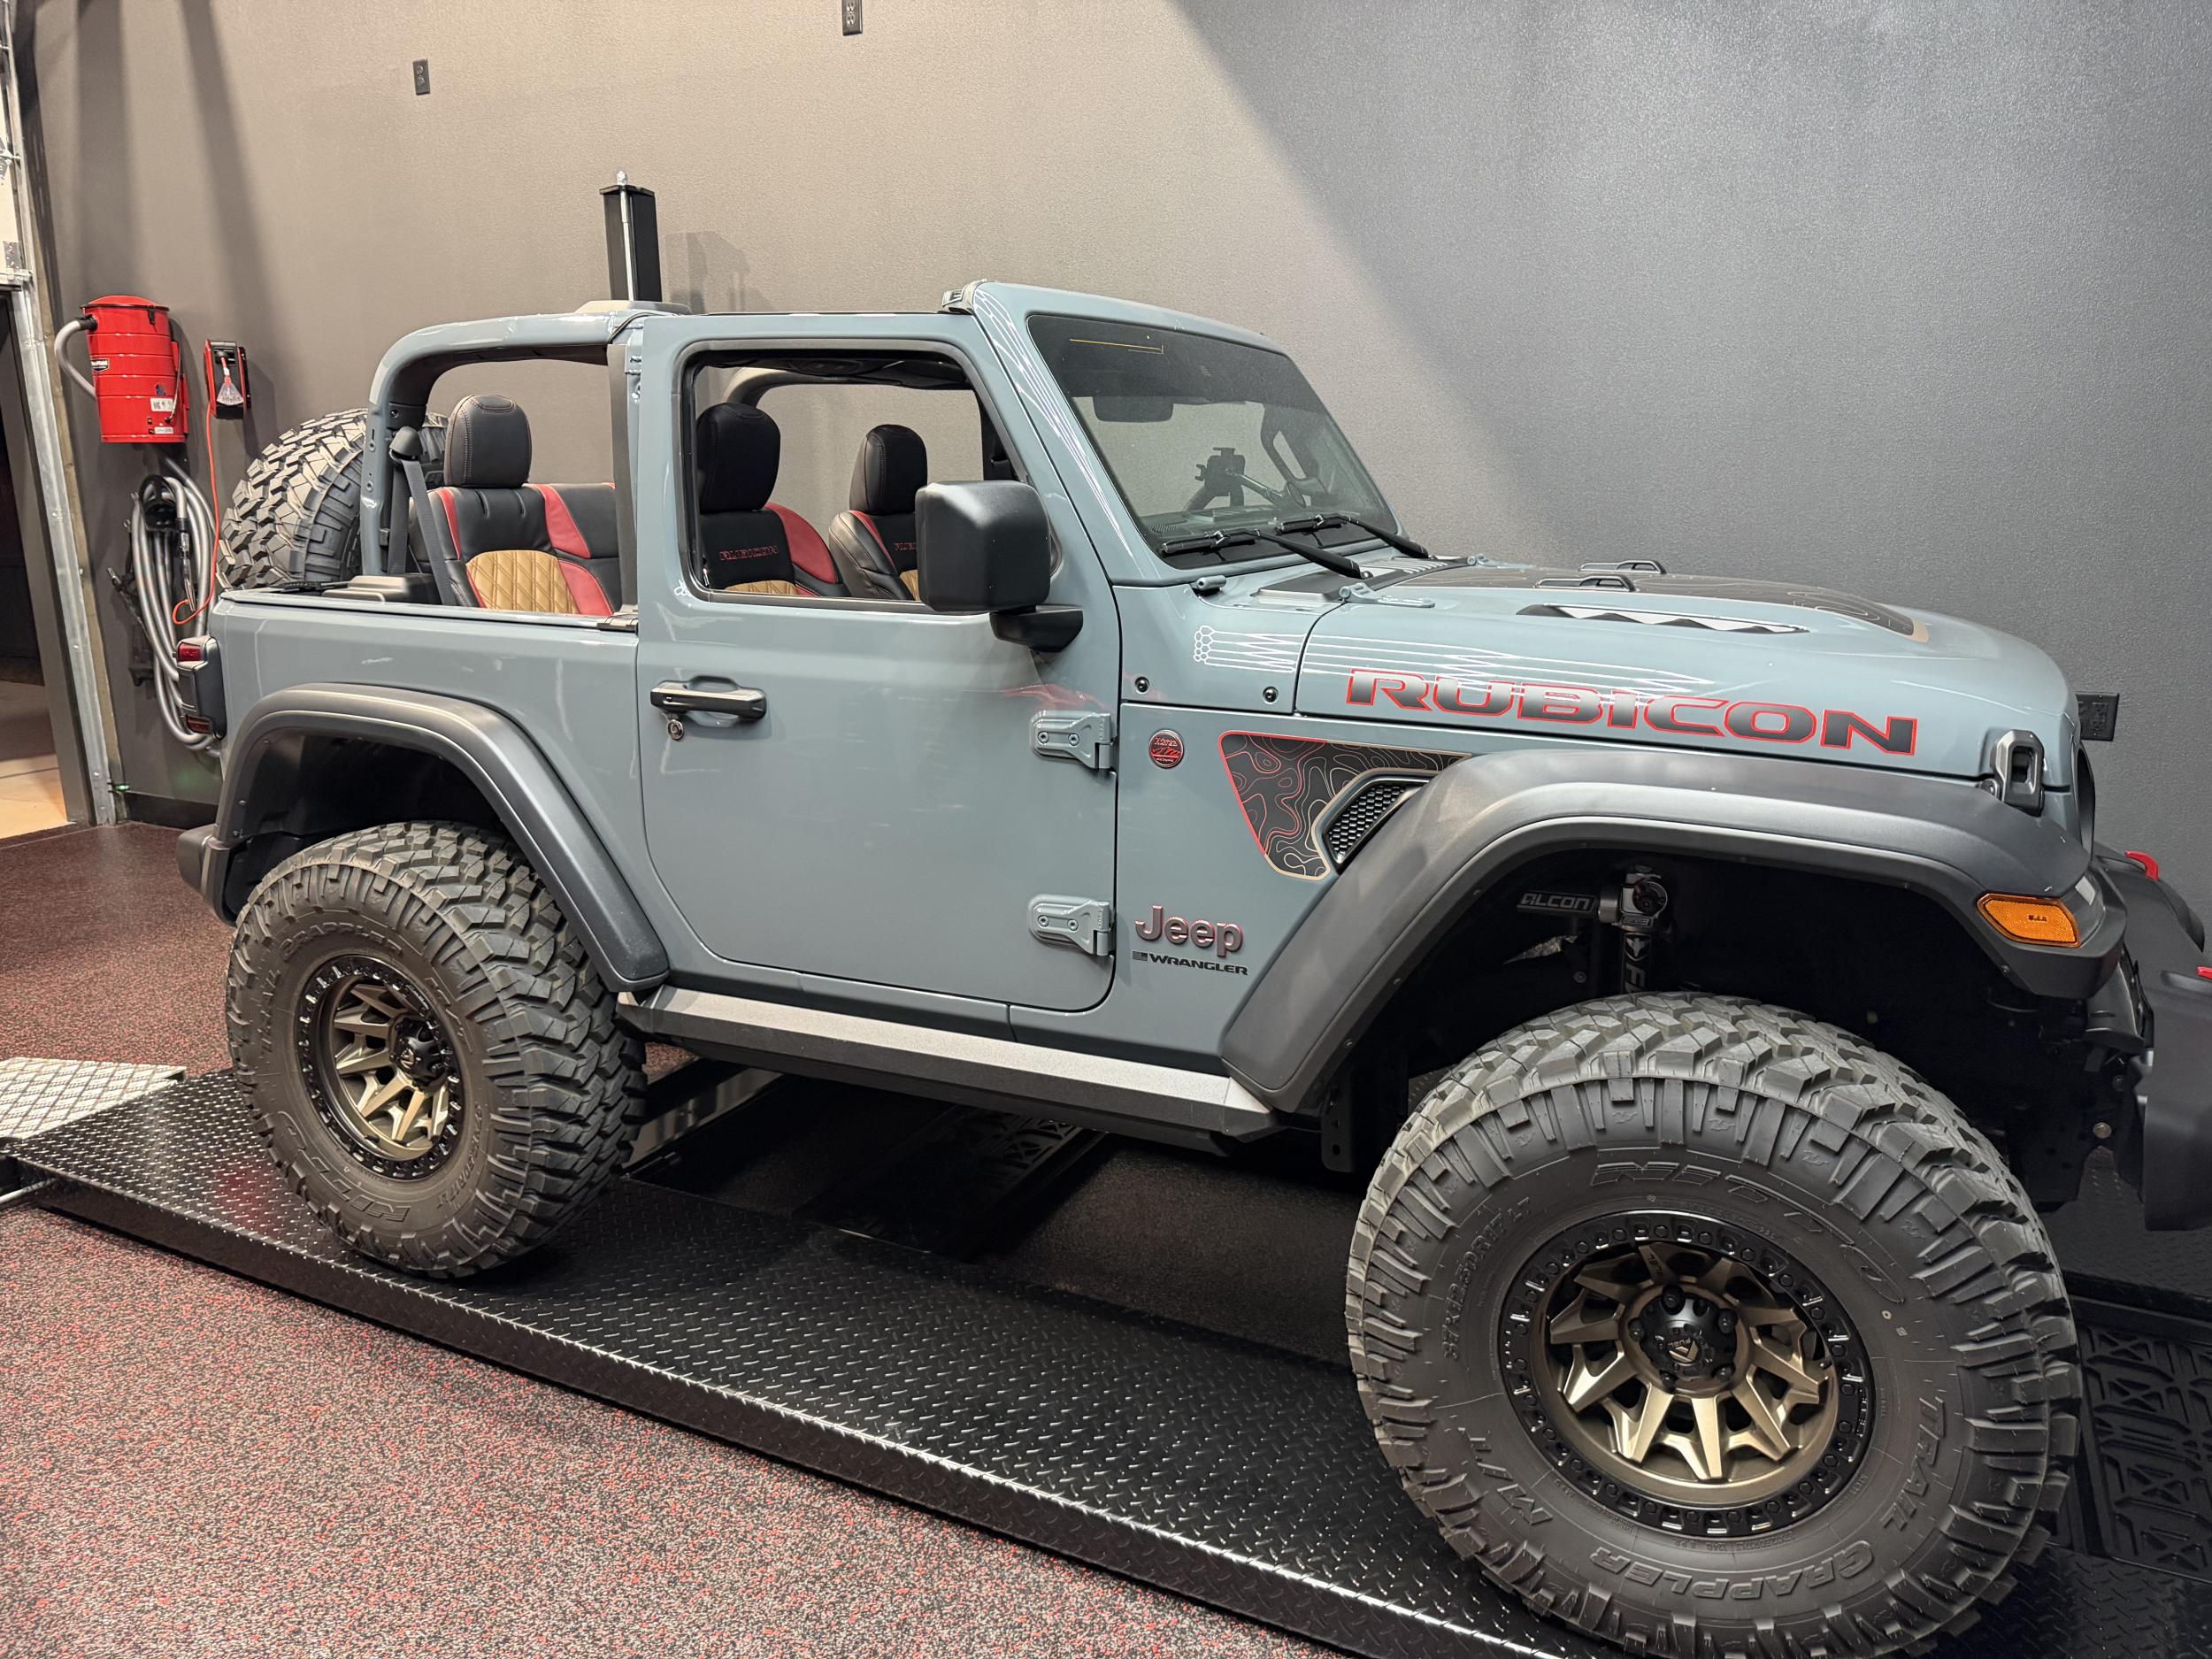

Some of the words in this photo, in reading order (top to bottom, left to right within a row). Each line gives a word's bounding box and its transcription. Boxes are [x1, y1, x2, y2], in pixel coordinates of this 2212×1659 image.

[718, 545, 780, 561] RUBICON
[1346, 667, 1918, 757] RUBICON
[1135, 904, 1244, 958] Jeep
[1148, 952, 1248, 976] WRANGLER
[1589, 1540, 1874, 1600] GRAPPLER
